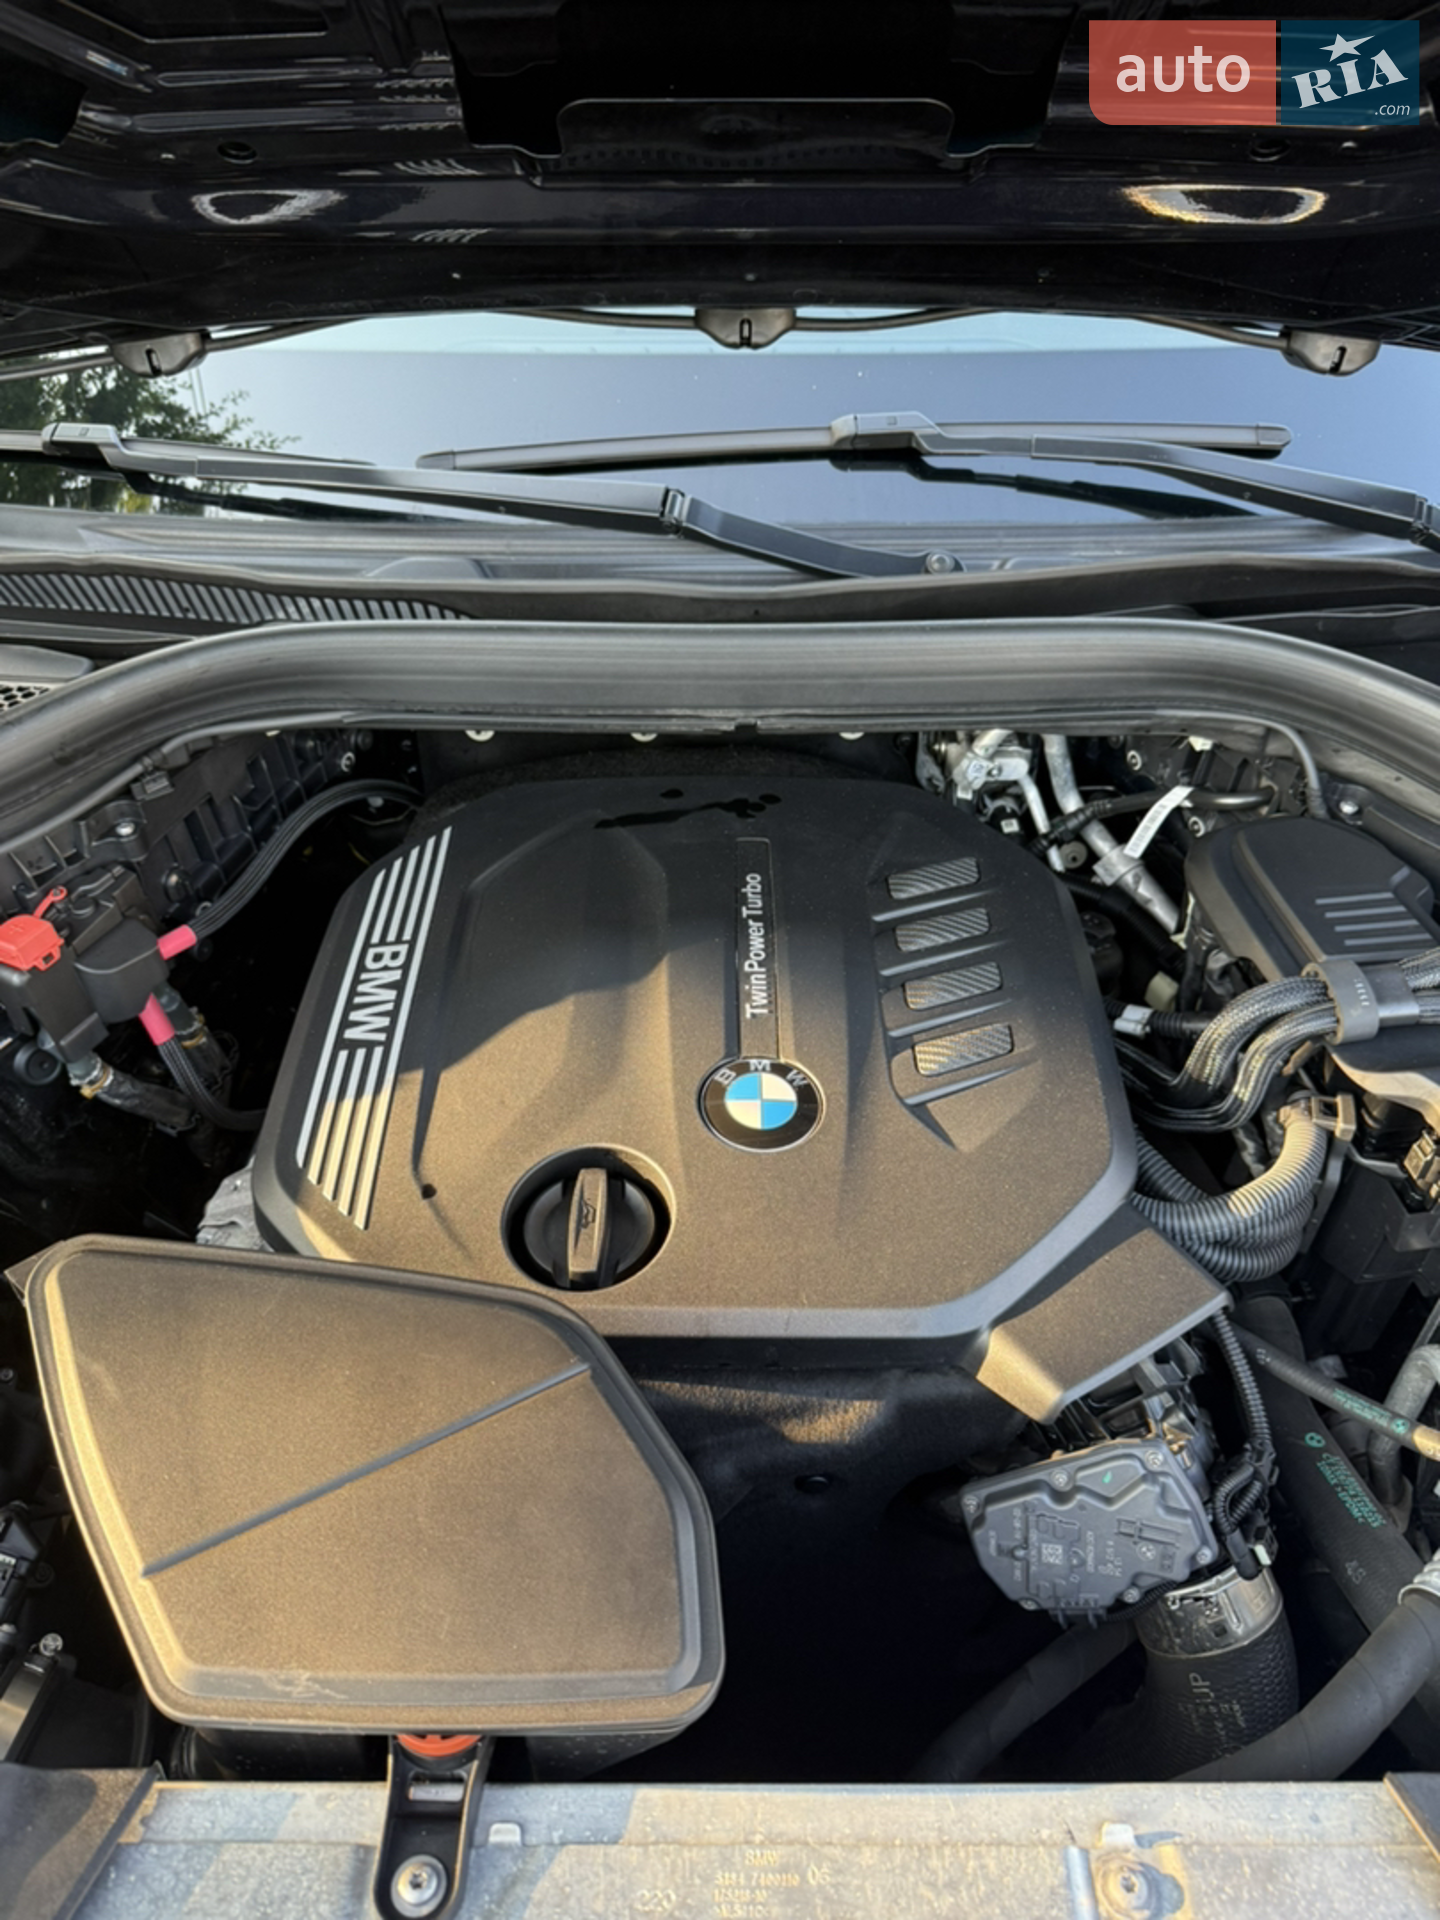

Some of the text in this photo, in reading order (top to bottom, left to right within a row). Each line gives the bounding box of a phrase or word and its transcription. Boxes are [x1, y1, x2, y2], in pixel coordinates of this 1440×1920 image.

[741, 873, 762, 918] Turbo
[343, 943, 409, 1042] BMW
[714, 1059, 808, 1088] BMW
